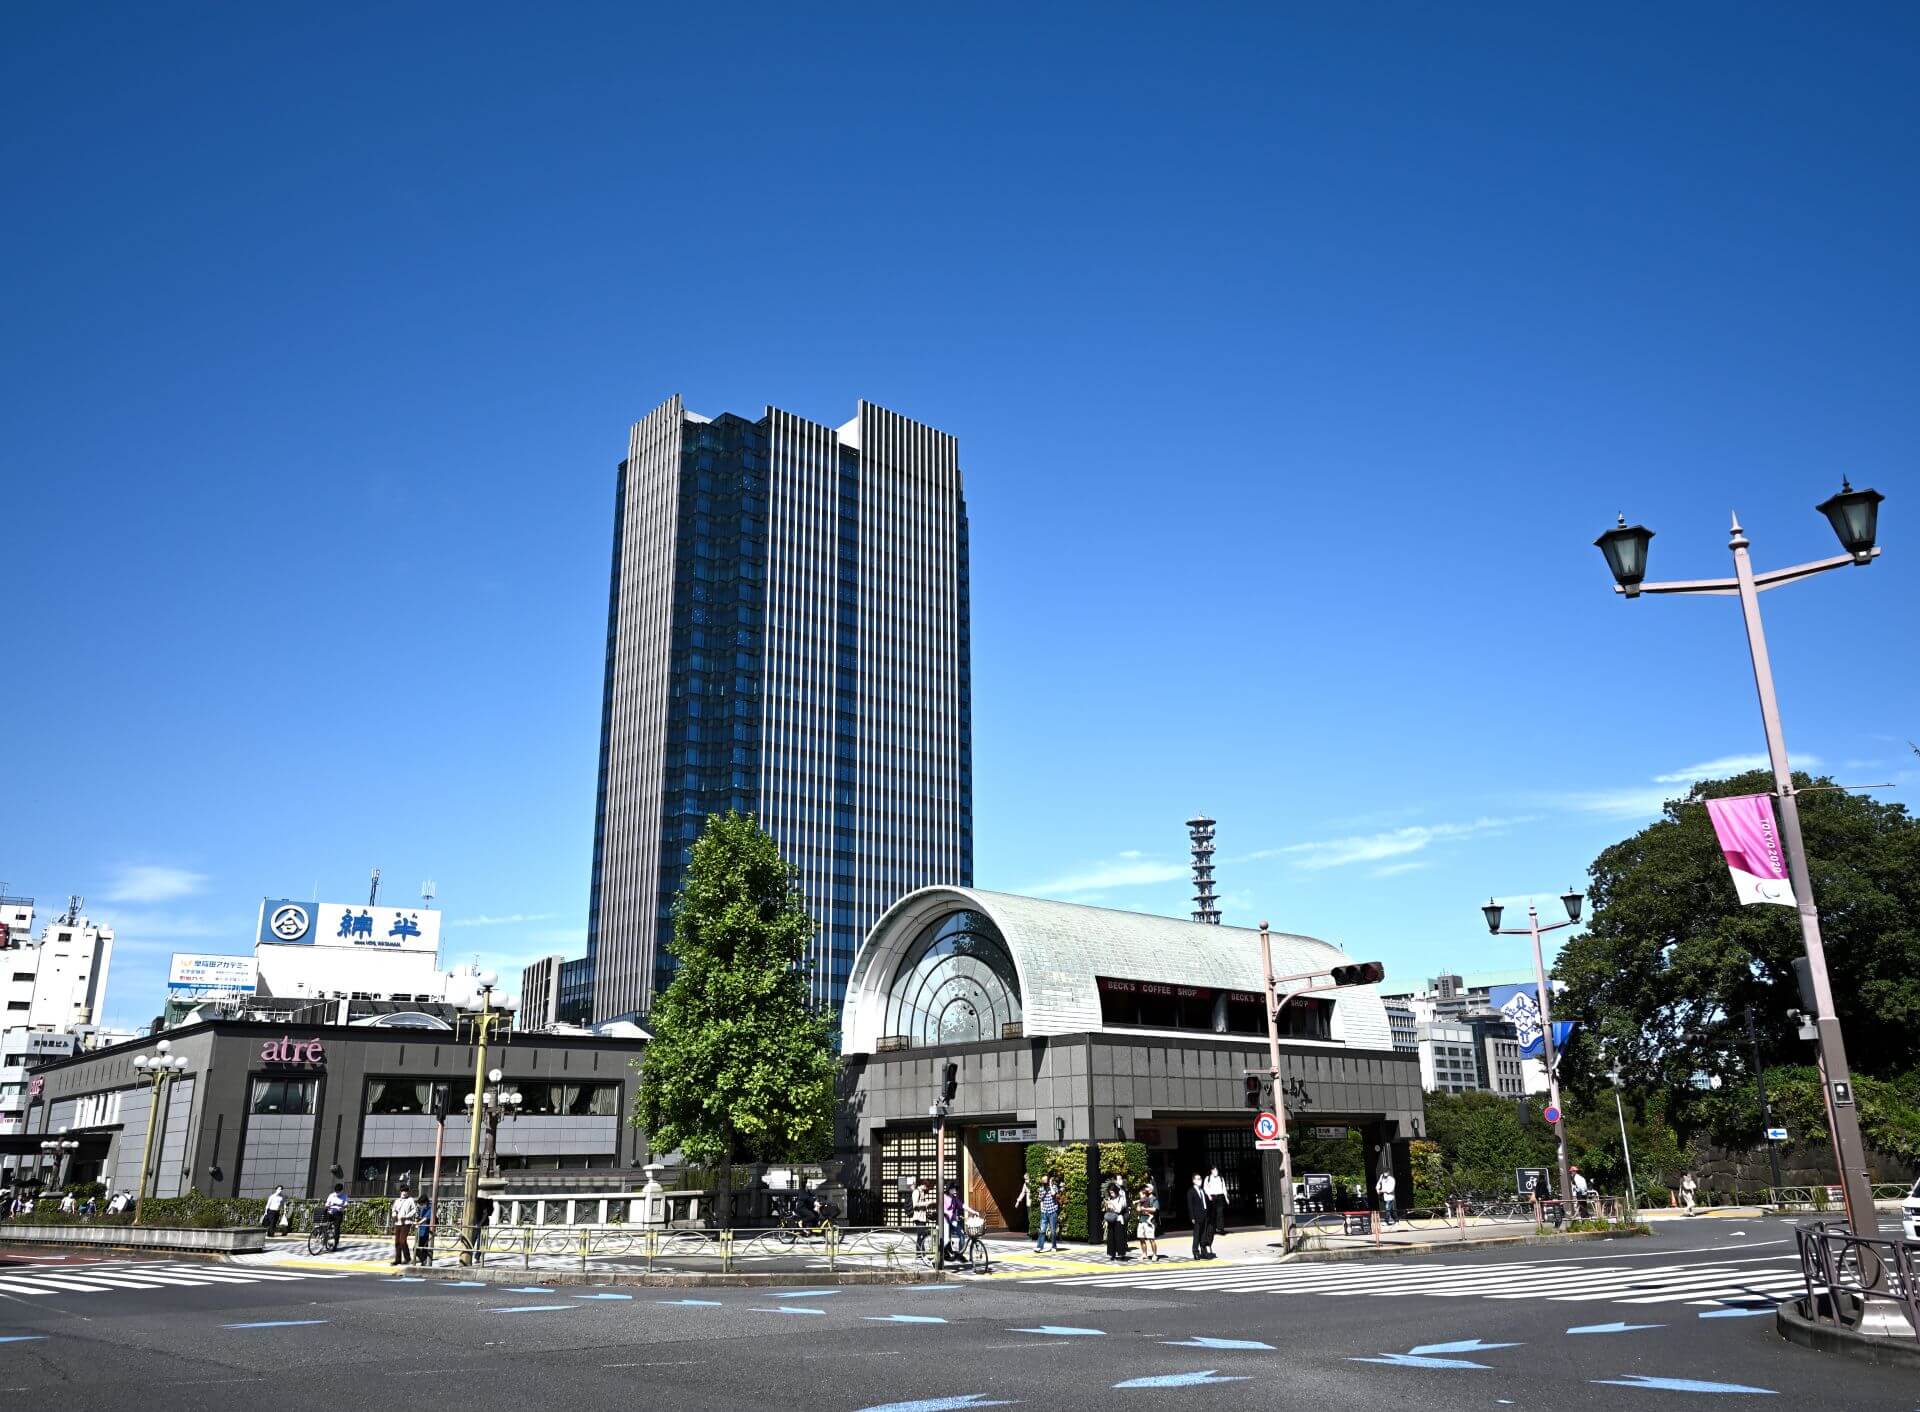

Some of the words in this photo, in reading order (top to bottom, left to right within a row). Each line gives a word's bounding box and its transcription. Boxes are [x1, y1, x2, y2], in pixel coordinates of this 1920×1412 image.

[1760, 818, 1776, 849] TOKYO
[1768, 850, 1782, 874] 2020
[1142, 984, 1171, 995] COFFEE
[1177, 988, 1198, 997] SHOP
[261, 1035, 323, 1062] atré
